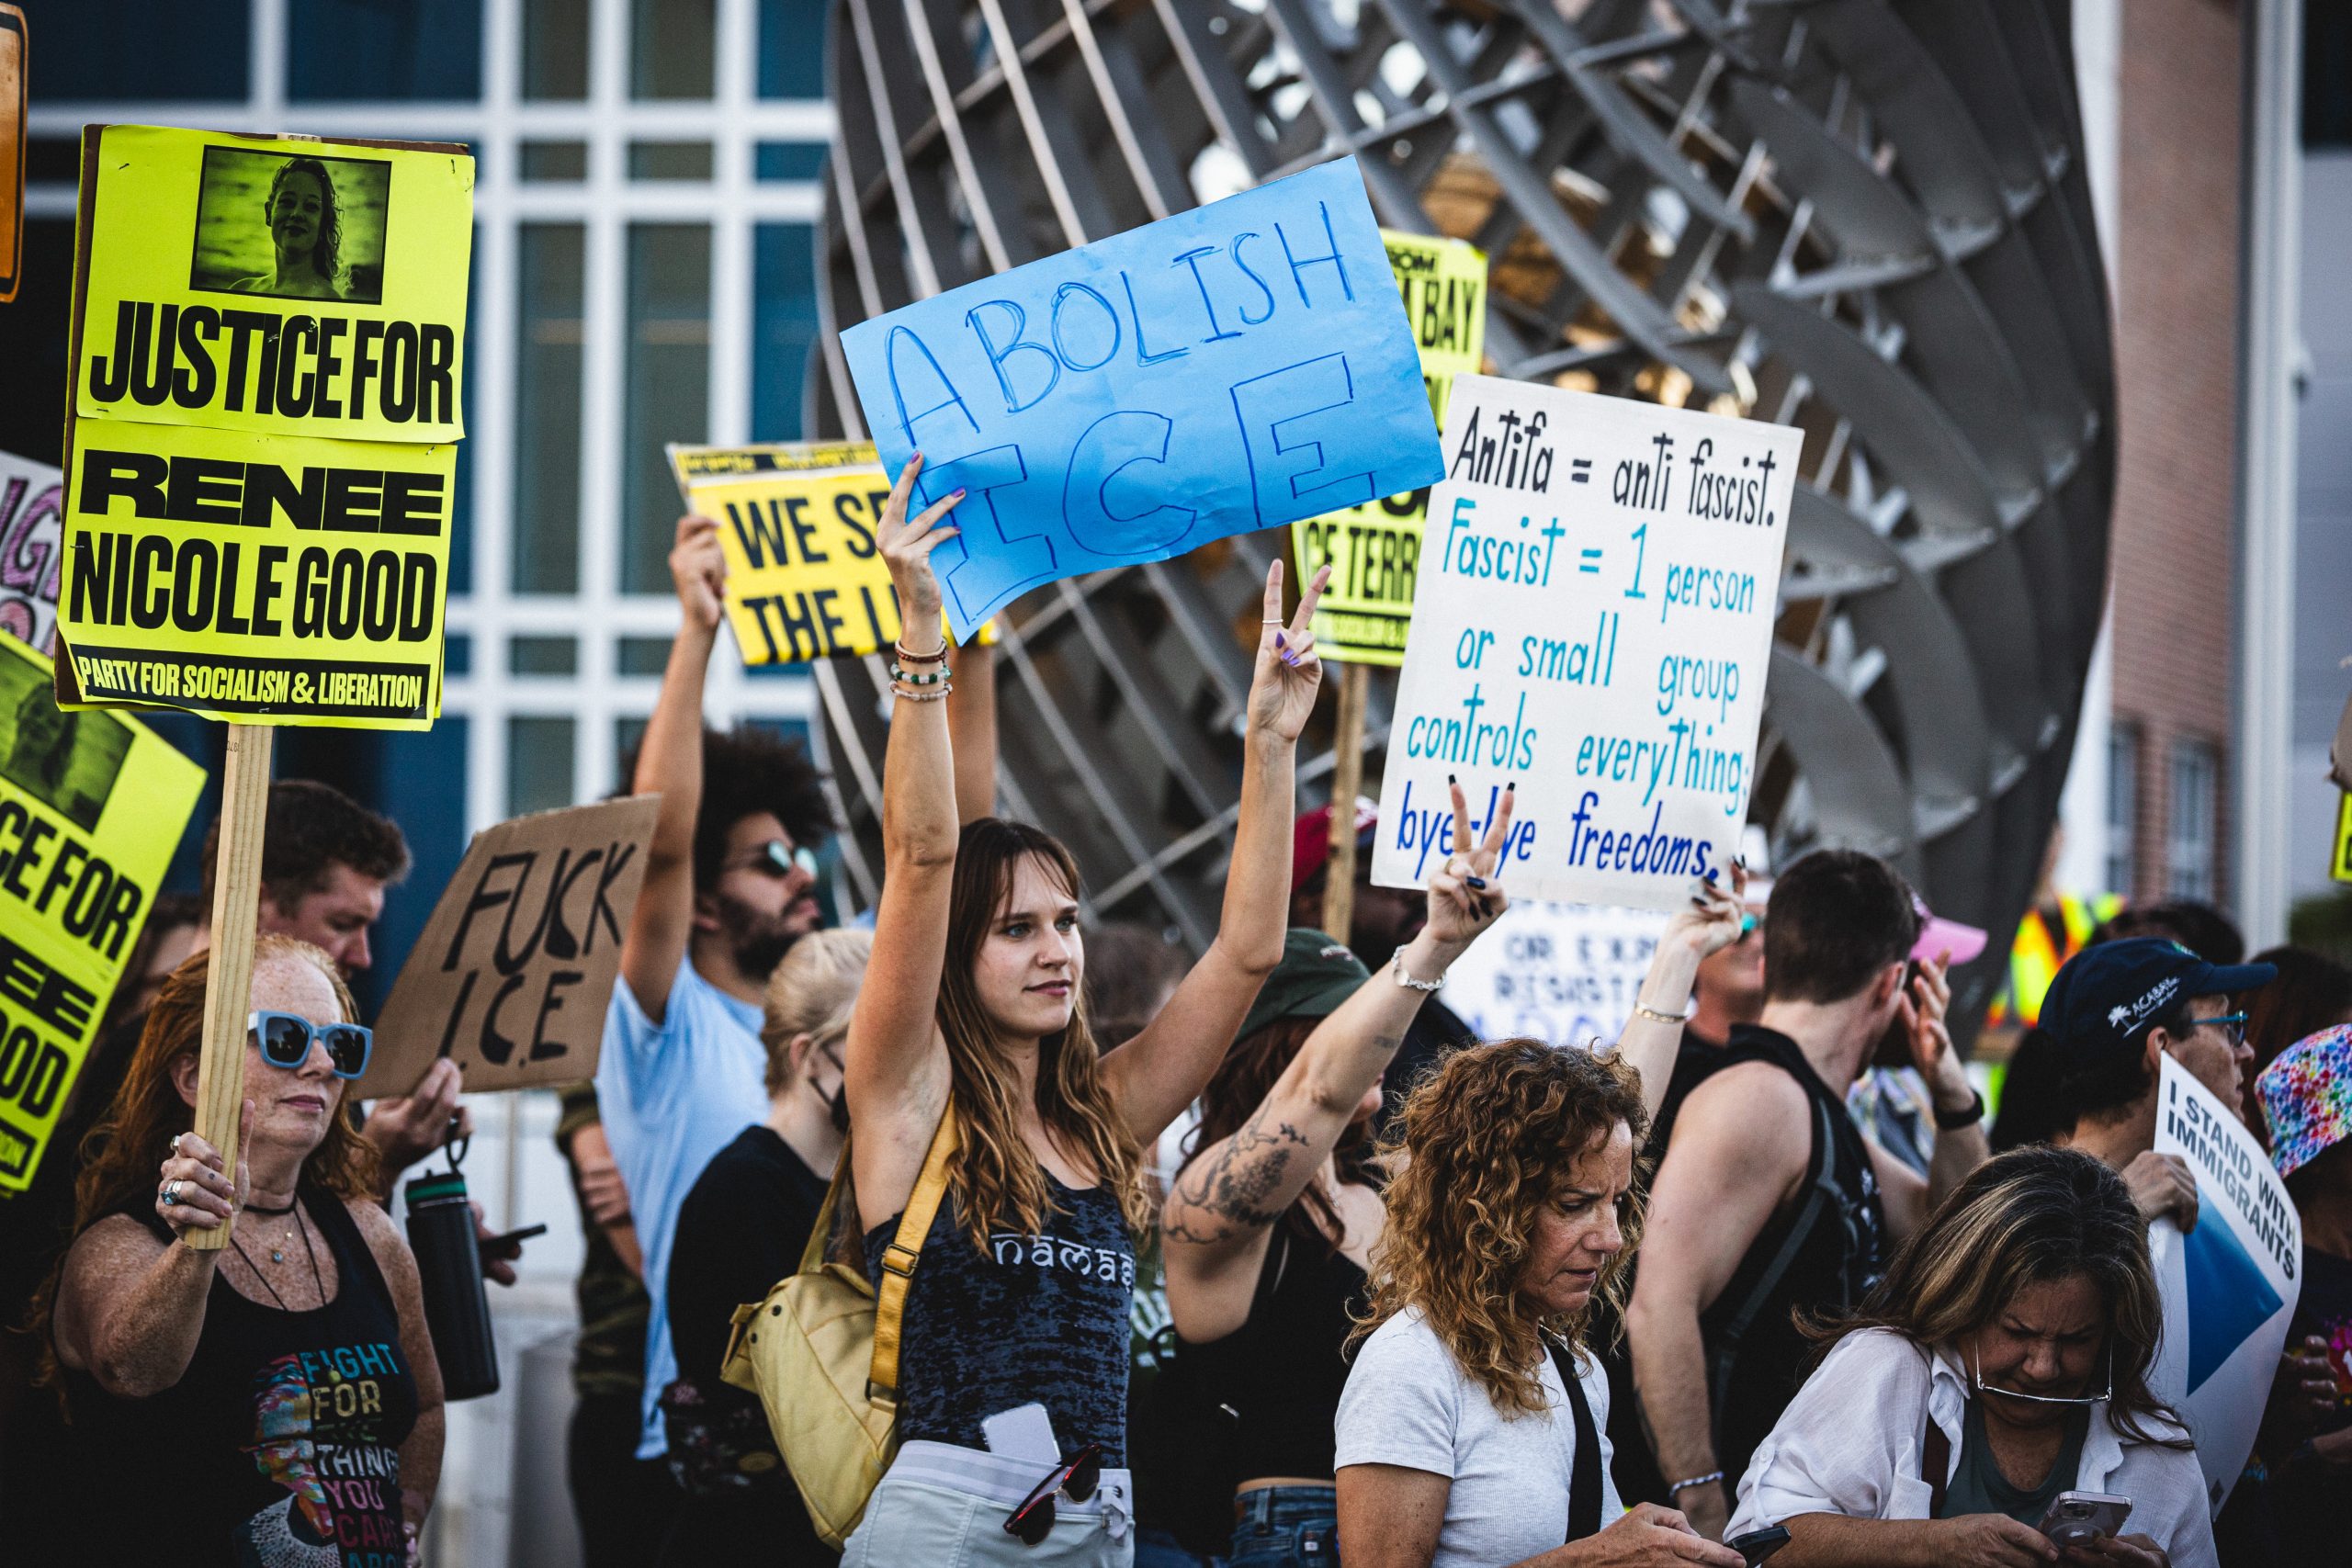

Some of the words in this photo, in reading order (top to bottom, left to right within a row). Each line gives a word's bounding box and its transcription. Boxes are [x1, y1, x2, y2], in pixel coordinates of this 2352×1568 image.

[88, 300, 347, 419] JUSTICE
[348, 317, 454, 424] FOR
[885, 199, 1356, 448] ABOLISH
[1420, 278, 1478, 354] BAY
[78, 449, 446, 536] RENEE
[916, 352, 1376, 626] ICE
[1450, 405, 1554, 493] Antifa
[1613, 432, 1674, 513] anti
[1688, 438, 1777, 527] fascist.
[69, 529, 288, 637] NICOLE
[292, 547, 437, 643] GOOD
[726, 497, 828, 570] WE
[1347, 525, 1421, 604] TERR
[1442, 498, 1566, 588] Fascist
[1623, 523, 1649, 601] 1
[1660, 561, 1756, 625] person
[77, 656, 140, 693] PARTY
[141, 661, 179, 698] FOR
[183, 665, 288, 704] SOCIALISM
[291, 676, 316, 705] &
[318, 672, 423, 708] LIBERATION
[742, 589, 854, 664] THE
[1455, 626, 1496, 671] or
[1518, 611, 1619, 688] small
[1657, 651, 1740, 724] group
[1407, 682, 1537, 771] controls
[1567, 789, 1721, 880] freedoms.
[35, 834, 143, 962] FOR
[441, 840, 637, 976] FUCK
[2166, 1109, 2295, 1281] IMMIGRANTS
[2169, 1078, 2177, 1106] I
[2185, 1094, 2252, 1181] STAND
[2257, 1170, 2297, 1251] WITH
[312, 1380, 383, 1421] FOR
[322, 1479, 385, 1511] YOU
